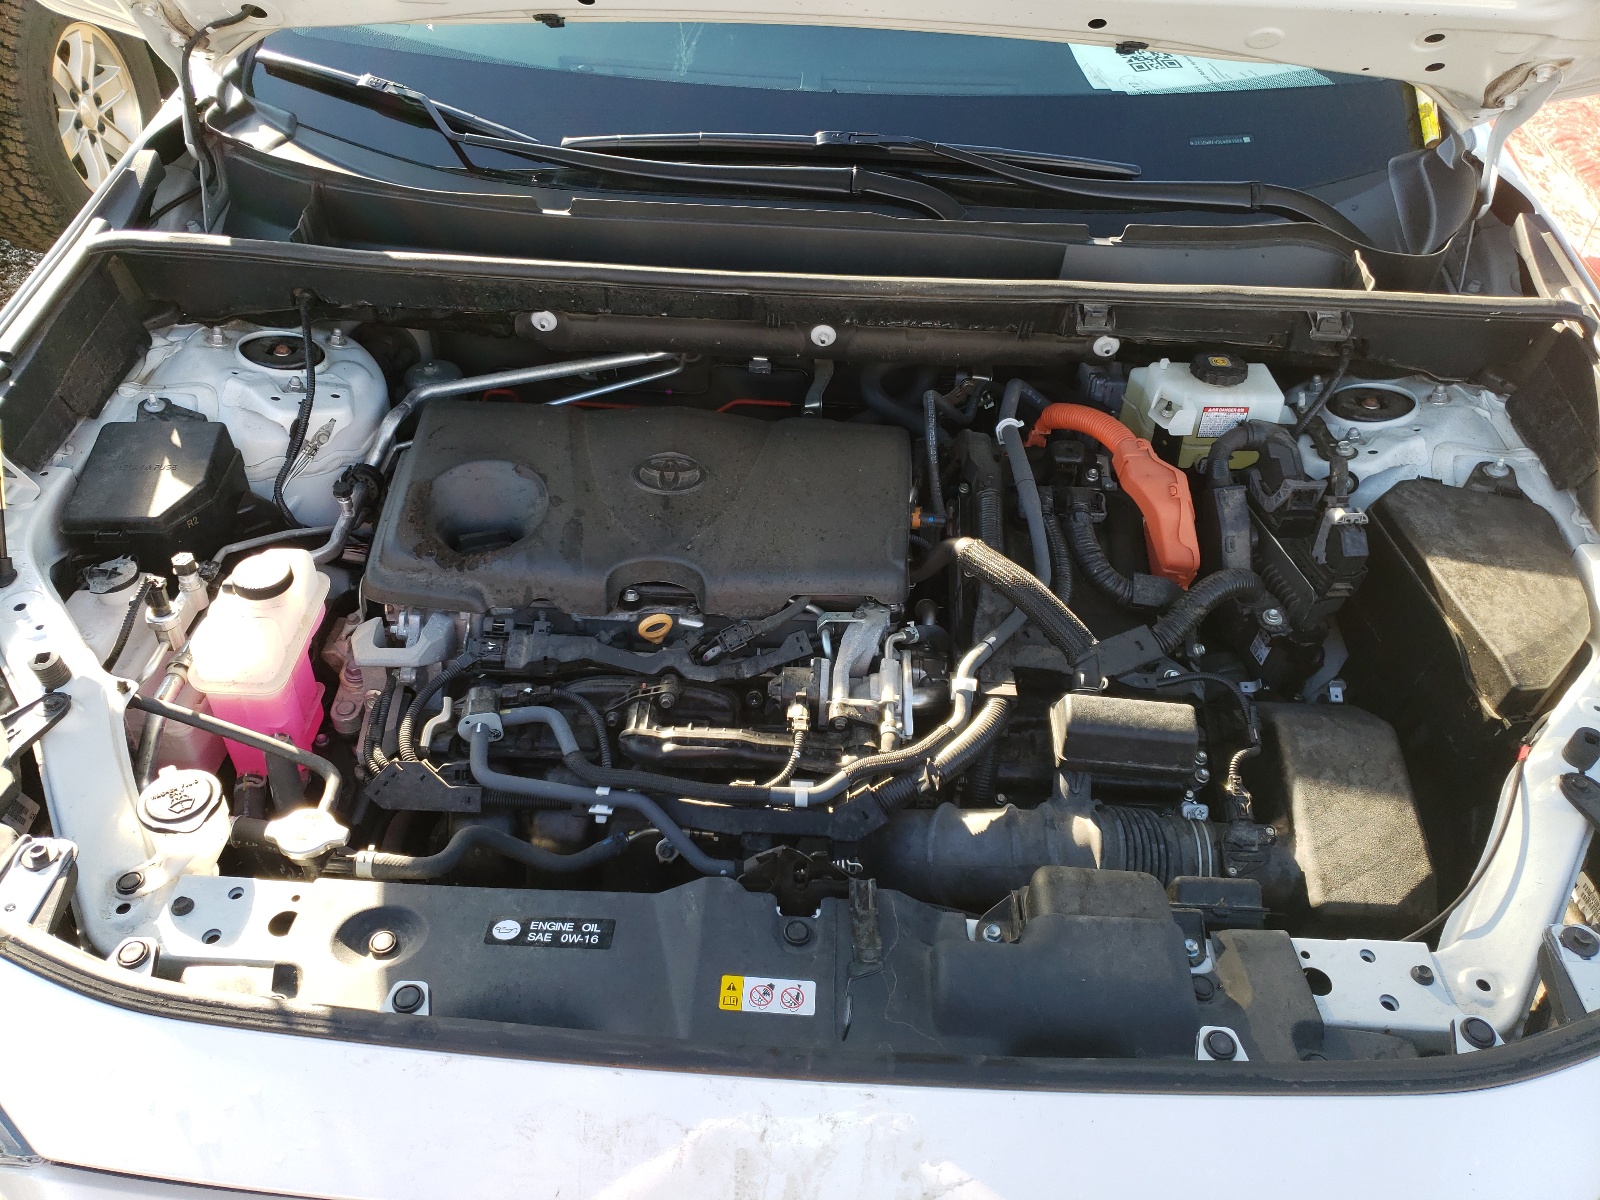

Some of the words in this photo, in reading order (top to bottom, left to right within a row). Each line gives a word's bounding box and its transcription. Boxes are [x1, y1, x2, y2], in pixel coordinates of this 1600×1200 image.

[186, 516, 200, 528] R2
[530, 921, 574, 931] ENGINE
[582, 923, 601, 932] OIL
[527, 932, 553, 942] SAE
[561, 933, 599, 943] 0W-16
